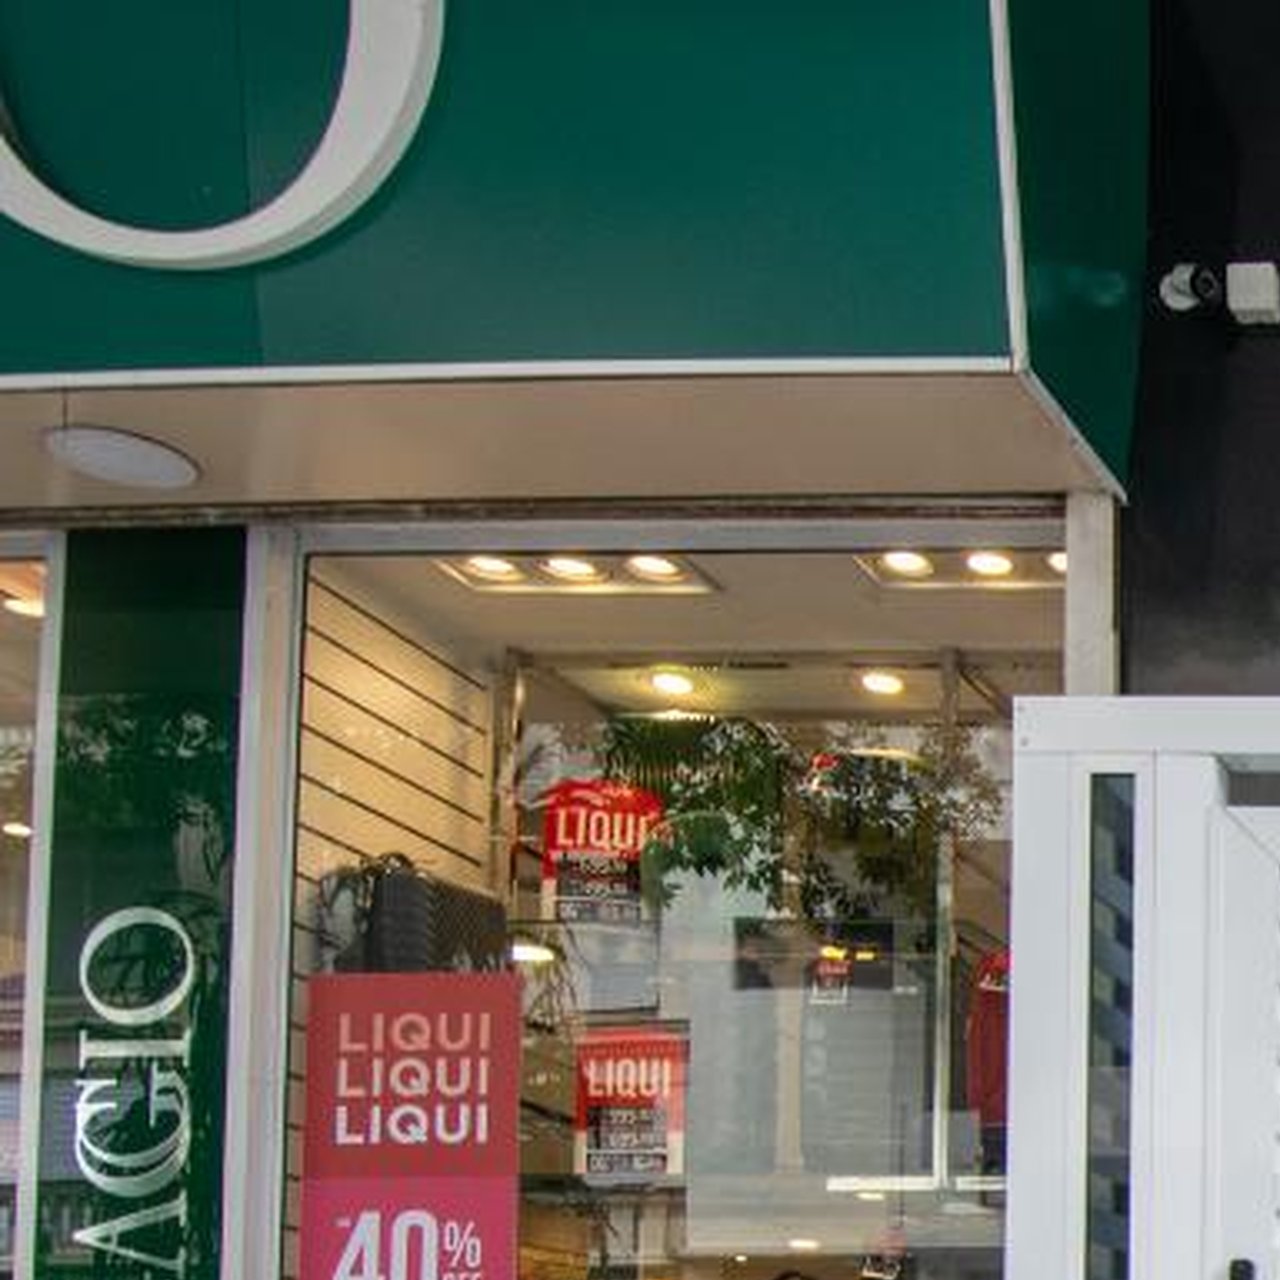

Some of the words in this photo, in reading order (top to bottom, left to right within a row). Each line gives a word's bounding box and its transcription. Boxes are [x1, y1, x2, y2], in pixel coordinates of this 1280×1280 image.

[338, 1012, 492, 1052] LIQUI
[336, 1056, 491, 1097] LIQUI
[588, 1056, 672, 1099] LIQUI
[334, 1103, 490, 1145] LIQUI
